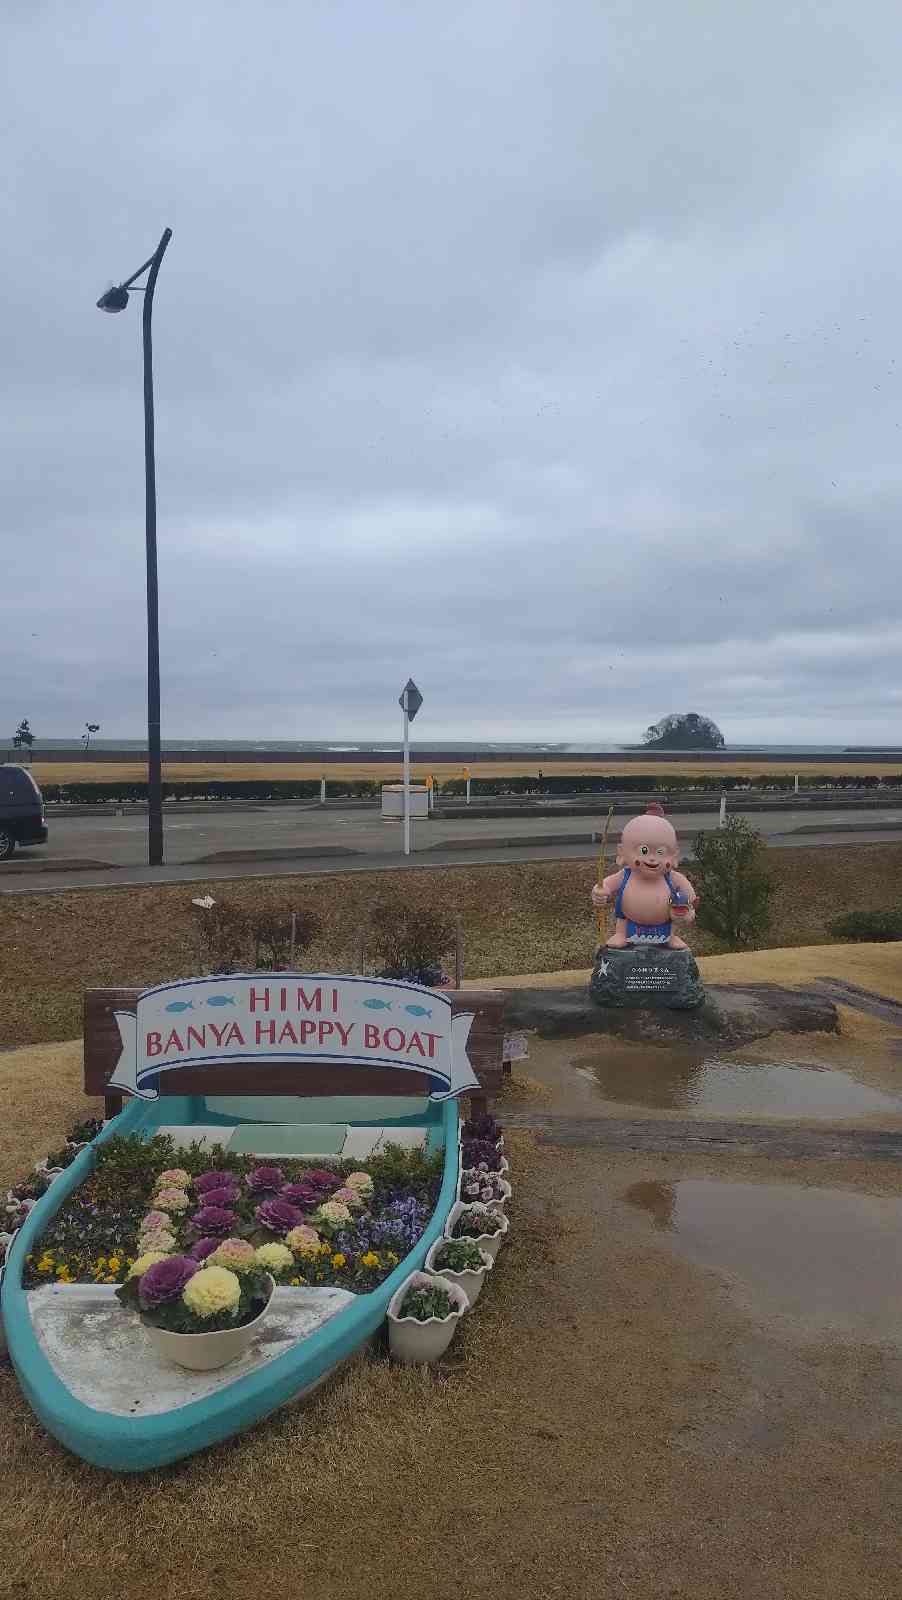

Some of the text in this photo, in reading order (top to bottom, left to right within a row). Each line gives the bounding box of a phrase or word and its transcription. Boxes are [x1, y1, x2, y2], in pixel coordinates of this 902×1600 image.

[249, 986, 339, 1013] HIMI
[145, 1019, 443, 1057] BANYA HAPPY BOAT
